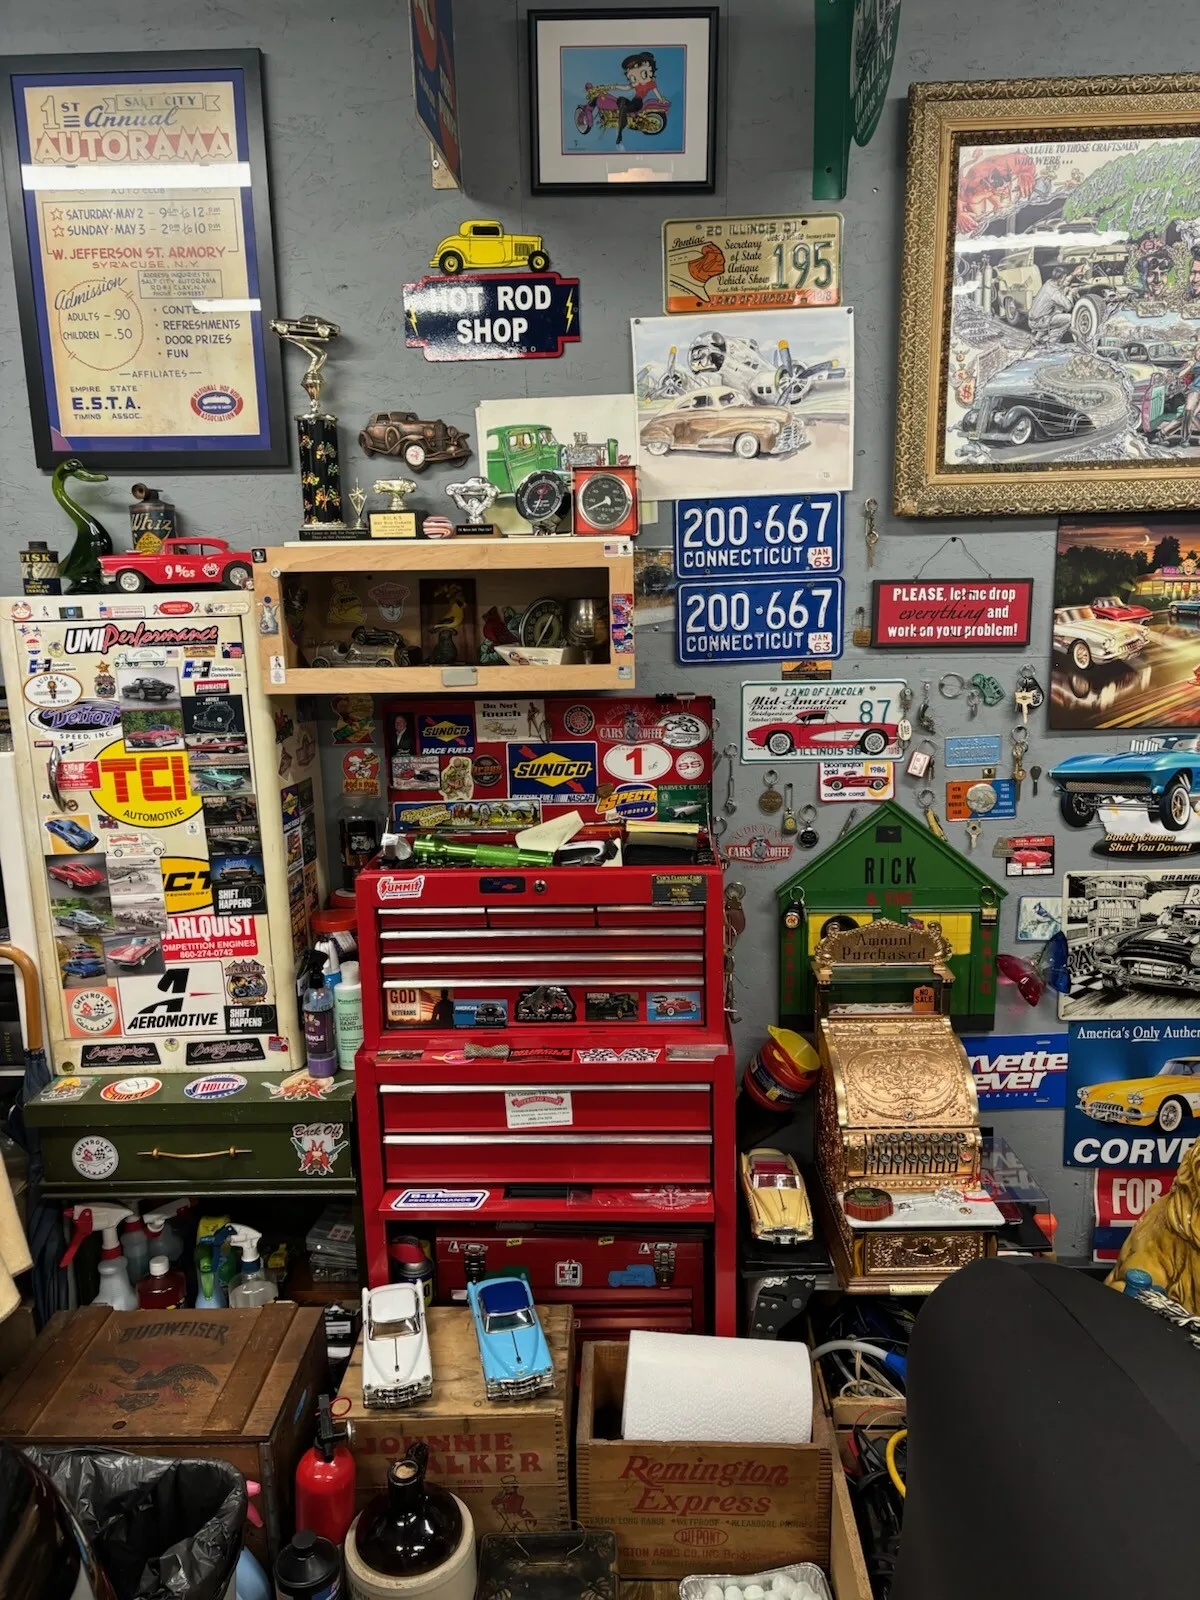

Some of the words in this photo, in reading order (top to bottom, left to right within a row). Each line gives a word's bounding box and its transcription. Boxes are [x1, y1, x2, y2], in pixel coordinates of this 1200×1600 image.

[165, 95, 196, 107] CITY
[34, 126, 233, 164] AUTORAMA
[1024, 145, 1055, 154] SALUTE
[1056, 145, 1066, 153] TO
[1067, 143, 1091, 153] THOSE
[1091, 141, 1141, 152] CRAFTSMEN
[192, 206, 205, 218] 12
[194, 223, 206, 235] 10
[729, 223, 777, 236] ILLINOIS
[724, 239, 762, 250] Secretary
[52, 249, 68, 261] W.
[70, 248, 142, 261] JEFFERSON
[146, 247, 165, 259] ST.
[169, 246, 226, 259] ARMORY
[741, 251, 762, 261] State
[727, 264, 760, 274] Antique
[773, 241, 834, 290] 195
[717, 275, 746, 286] Vehicle
[748, 274, 770, 284] Show
[54, 278, 128, 311] Admission
[496, 285, 552, 311] ROD
[67, 309, 100, 322] ADULTS
[163, 319, 241, 330] REFRESHMENTS
[456, 317, 529, 344] SHOP
[62, 331, 100, 341] CHILDREN
[165, 335, 193, 345] DOOR
[195, 334, 232, 345] PRIZES
[166, 349, 189, 359] FUN
[131, 370, 188, 379] AFFILIATES
[70, 385, 101, 393] EMPIRE
[110, 385, 138, 393] STATE
[71, 396, 142, 411] E.S.T.A.
[131, 512, 173, 531] Whiz
[21, 553, 51, 562] FISK
[683, 547, 804, 568] CONNECTICUT
[811, 548, 829, 556] JAN
[813, 556, 831, 568] 63
[165, 565, 173, 580] 9
[950, 586, 967, 601] let
[968, 588, 987, 601] me
[988, 586, 1016, 603] drop
[987, 605, 1009, 619] and
[811, 633, 829, 641] JAN
[887, 624, 917, 637] work
[920, 625, 934, 637] on
[936, 624, 962, 640] your
[964, 623, 1018, 640] problem!
[65, 628, 105, 654] UMI
[102, 622, 218, 654] Performance
[686, 632, 804, 653] CONNECTICUT
[813, 641, 831, 652] 63
[35, 675, 69, 689] AUDRAIN
[784, 687, 809, 697] LAND
[812, 687, 823, 696] OF
[825, 686, 866, 696] LINCOLN
[748, 696, 848, 706] Mid-America
[42, 704, 121, 729] Detroit
[482, 710, 522, 718] Touch
[859, 699, 892, 725] 87
[94, 731, 113, 739] INC.
[424, 727, 470, 737] SUNOCO
[600, 728, 623, 738] CARS
[640, 728, 663, 739] COFFEE
[447, 747, 475, 755] FUELS
[799, 747, 844, 756] ILLINOIS
[626, 747, 643, 776] 1
[678, 760, 702, 771] SS
[517, 763, 589, 777] SUNOCO
[824, 769, 839, 777] gold
[869, 766, 886, 774] 1986
[101, 756, 187, 803] TCI
[567, 794, 595, 803] NASCAR
[122, 807, 185, 822] AUTOMOTIVE
[1105, 832, 1140, 843] Buddy
[1140, 832, 1177, 842] Gonna
[728, 847, 751, 857] CARS
[766, 847, 790, 857] COFFEE
[1108, 842, 1135, 852] Shut
[1136, 843, 1156, 852] You
[1156, 842, 1192, 852] Down!
[864, 857, 917, 885] RICK
[380, 878, 422, 896] SUMMIT
[218, 888, 240, 900] SHIFT
[218, 898, 252, 910] HAPPENS
[162, 915, 253, 942] ARLQUIST
[217, 940, 256, 950] ENGINES
[856, 933, 913, 946] Amount
[180, 948, 234, 959] 860-274-0742
[841, 948, 926, 961] Purchased
[390, 989, 416, 1003] GOD
[919, 988, 929, 996] NO
[74, 992, 113, 1010] CHEVROLET
[915, 995, 933, 1003] SALE
[229, 1008, 251, 1018] SHIFT
[126, 1012, 219, 1030] AEROMOTIVE
[229, 1017, 263, 1028] HAPPENS
[1077, 1026, 1130, 1039] America's
[1132, 1025, 1161, 1042] Only
[968, 1051, 1069, 1072] rvette
[201, 1082, 239, 1093] HOLLEY
[975, 1071, 1047, 1092] ever
[110, 1091, 147, 1101] HURST
[293, 1124, 323, 1138] Back
[323, 1122, 344, 1138] Off
[75, 1139, 113, 1157] CHEVROLET
[1112, 1178, 1163, 1215] FOR
[119, 1320, 229, 1346] BUDWEISER
[618, 1455, 790, 1488] Remington
[632, 1488, 772, 1517] Express
[618, 1517, 639, 1525] LONG
